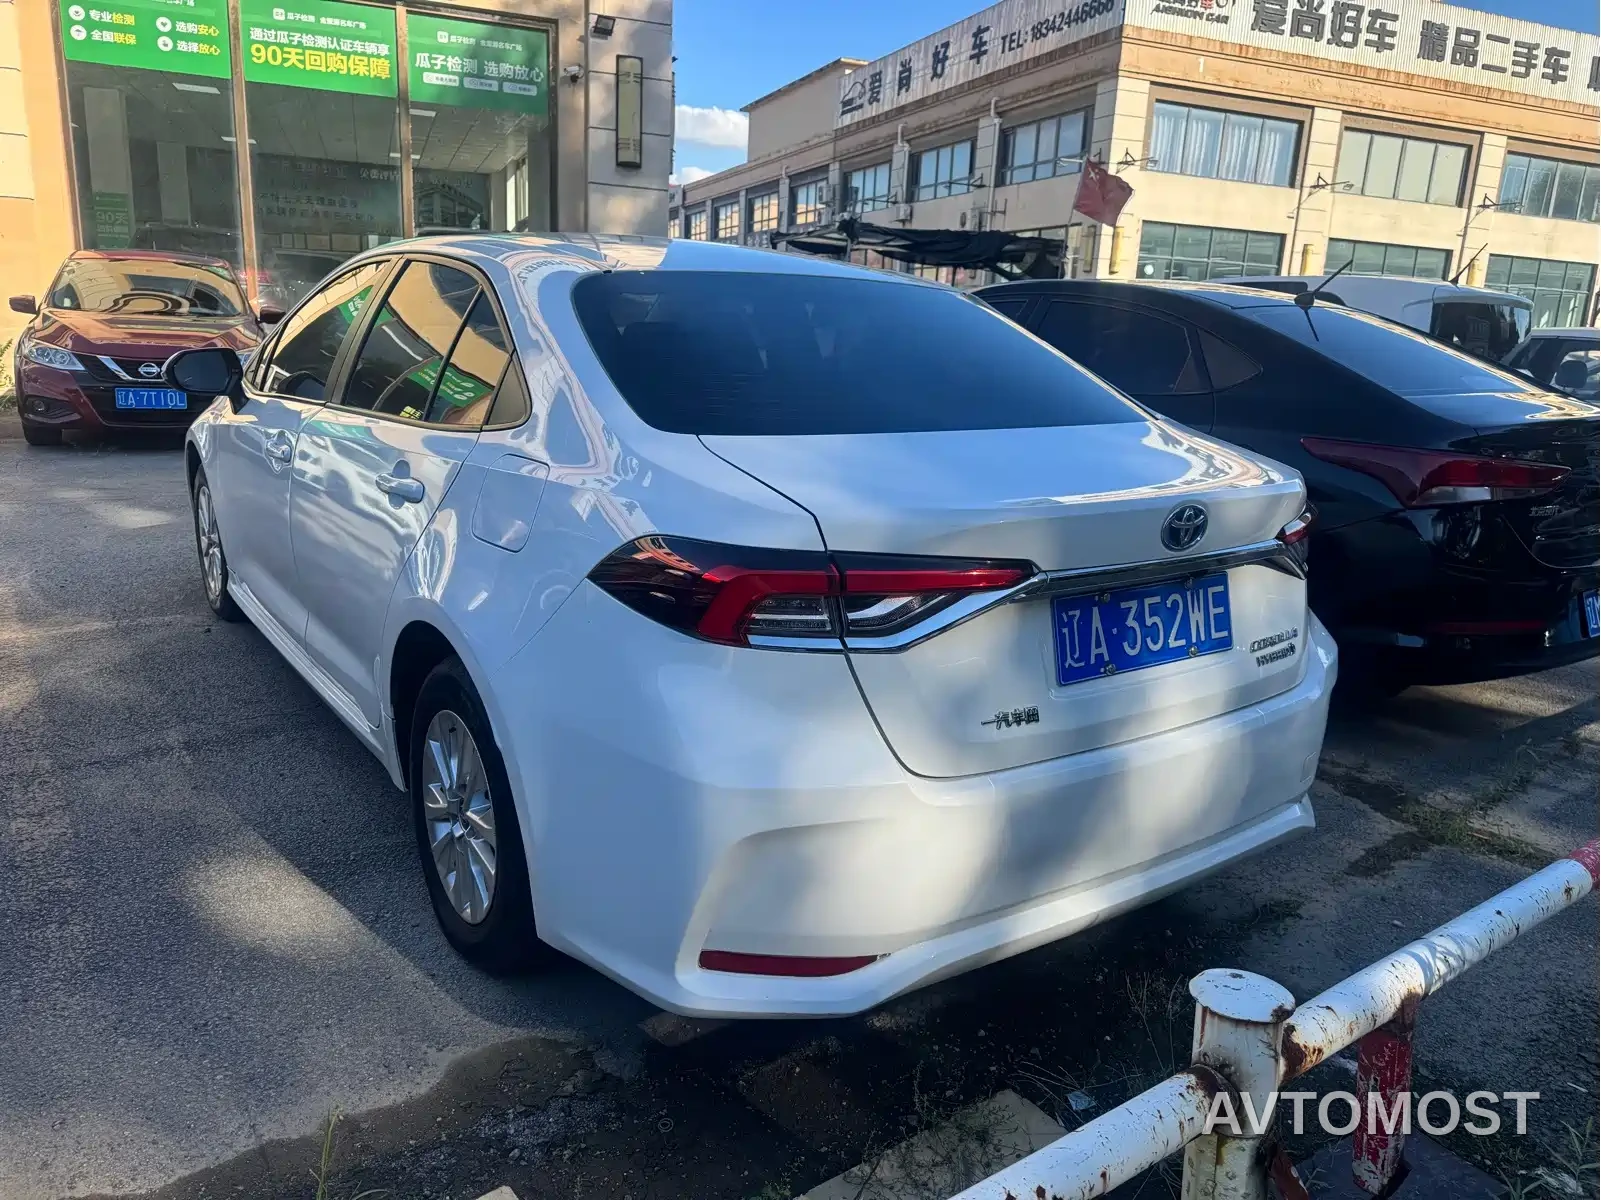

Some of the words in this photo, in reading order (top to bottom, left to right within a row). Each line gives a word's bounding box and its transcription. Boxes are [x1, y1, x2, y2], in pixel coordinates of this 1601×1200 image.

[89, 9, 135, 26] 专业检测
[175, 20, 220, 37] 选购安心
[1251, 0, 1399, 52] 爱尚好车
[90, 29, 137, 45] 全国联保
[176, 40, 221, 56] 选择放心
[250, 27, 390, 56] 通过瓜子检测认证车辆享
[251, 43, 391, 79] 90天回购保障
[868, 24, 991, 105] 爱尚好车
[1417, 20, 1572, 84] 精品二手车
[415, 53, 477, 74] 瓜子检测
[484, 60, 544, 83] 选购放心
